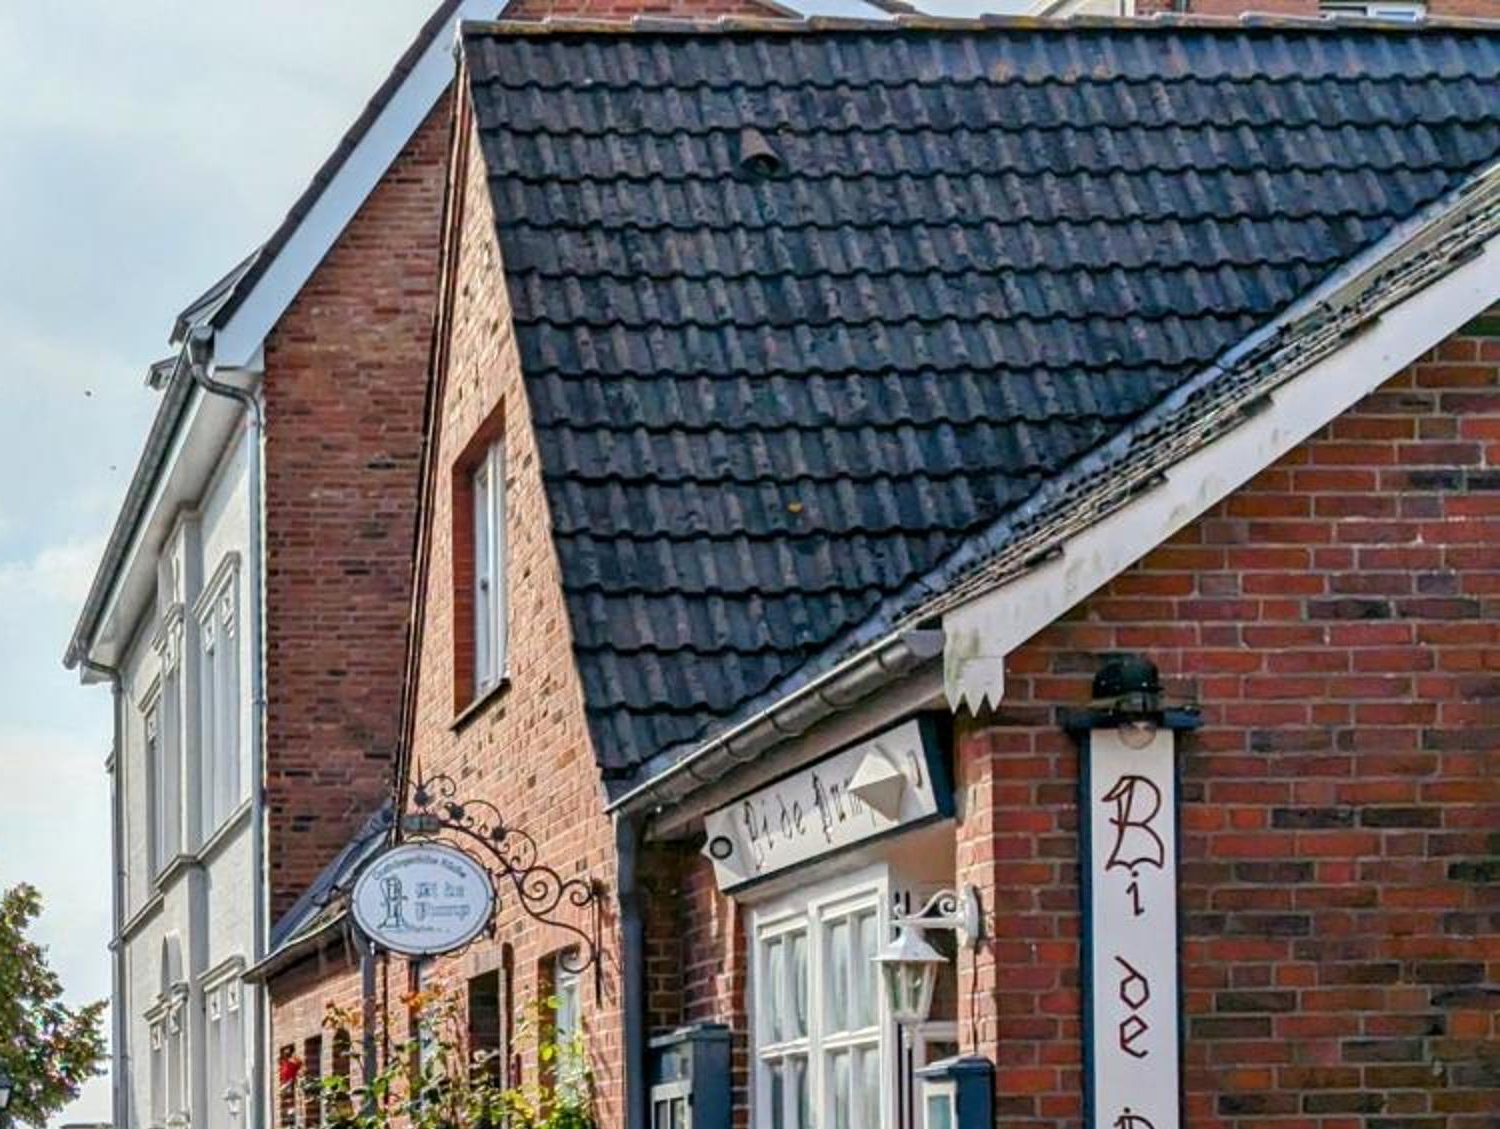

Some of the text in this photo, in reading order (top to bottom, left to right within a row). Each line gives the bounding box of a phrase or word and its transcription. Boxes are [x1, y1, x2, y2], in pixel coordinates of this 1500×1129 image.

[811, 769, 878, 844] Pum
[1100, 774, 1166, 917] Bi
[1113, 955, 1150, 1059] de
